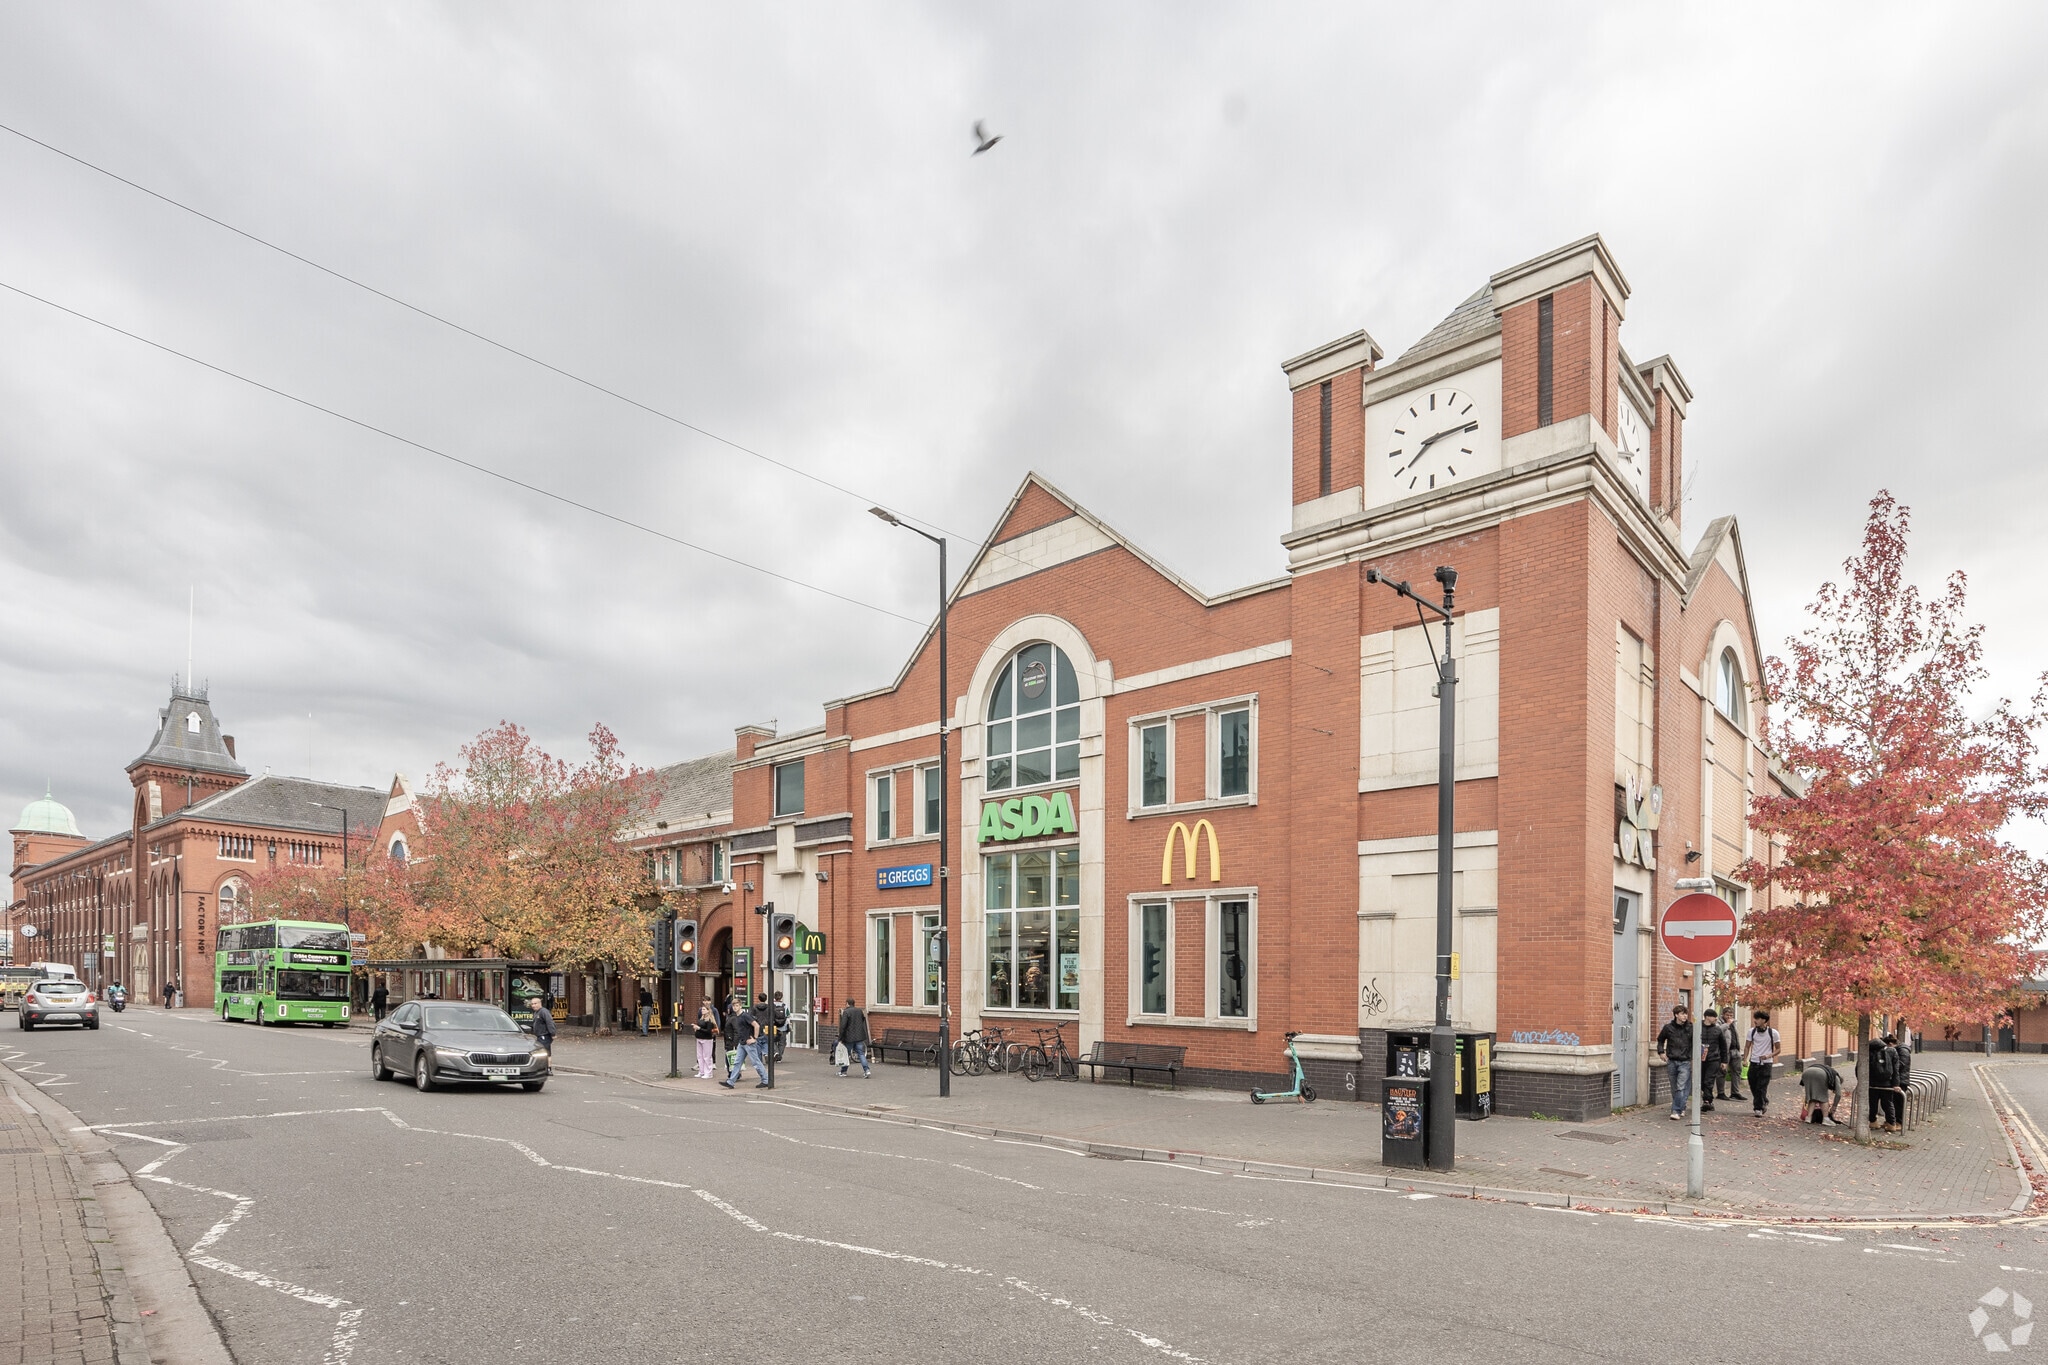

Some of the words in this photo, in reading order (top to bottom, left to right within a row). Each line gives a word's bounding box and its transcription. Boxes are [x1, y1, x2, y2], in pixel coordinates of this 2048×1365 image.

[977, 792, 1078, 843] ASDA
[888, 868, 928, 884] GREGGS
[329, 955, 338, 963] 75
